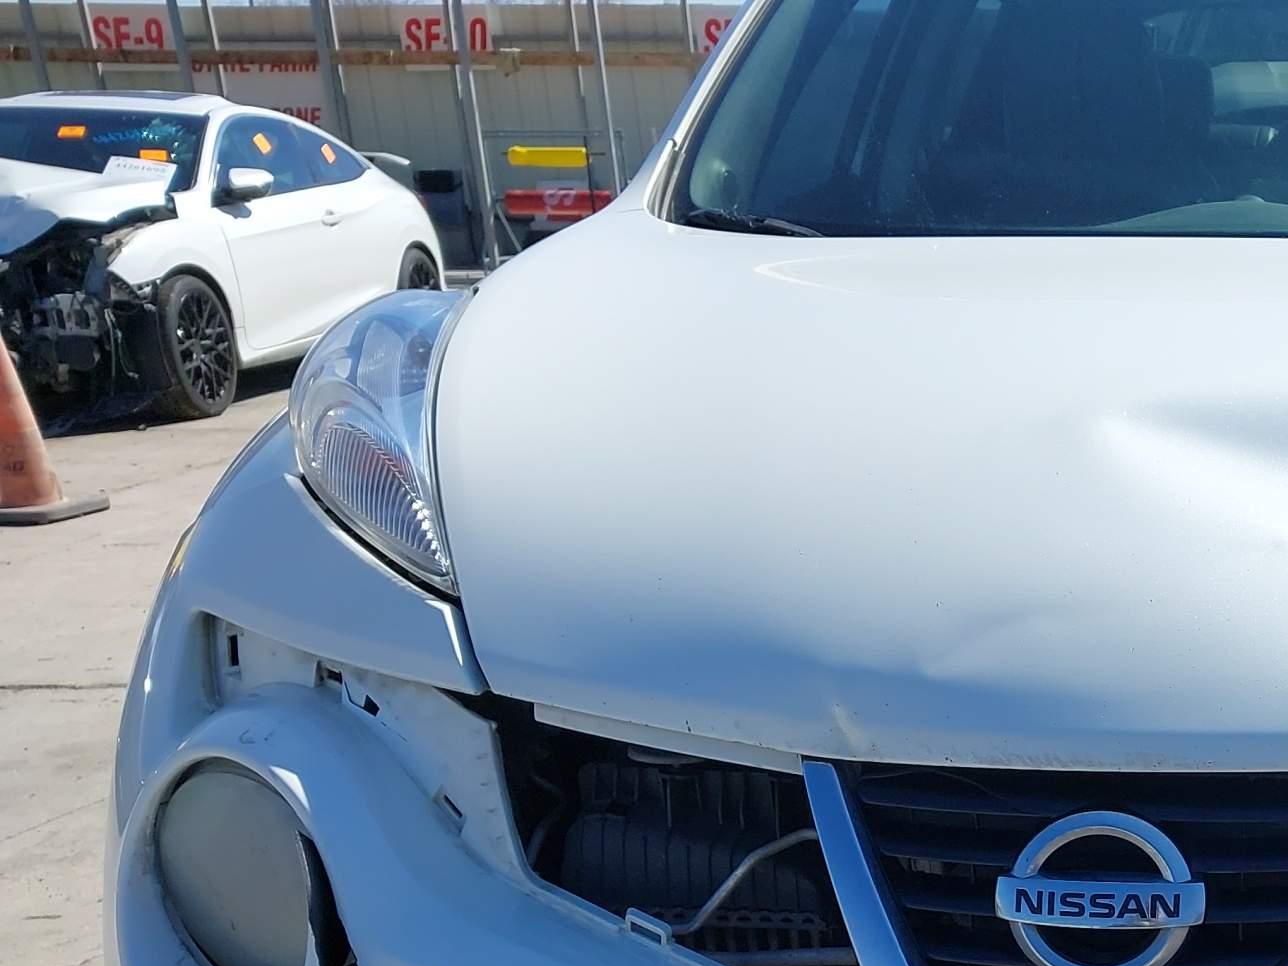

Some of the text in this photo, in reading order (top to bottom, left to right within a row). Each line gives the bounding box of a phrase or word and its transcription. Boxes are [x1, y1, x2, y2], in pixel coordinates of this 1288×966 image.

[93, 16, 164, 50] SF-9
[405, 17, 487, 50] SF-0
[704, 18, 732, 53] S
[1015, 888, 1181, 919] NISSAN
